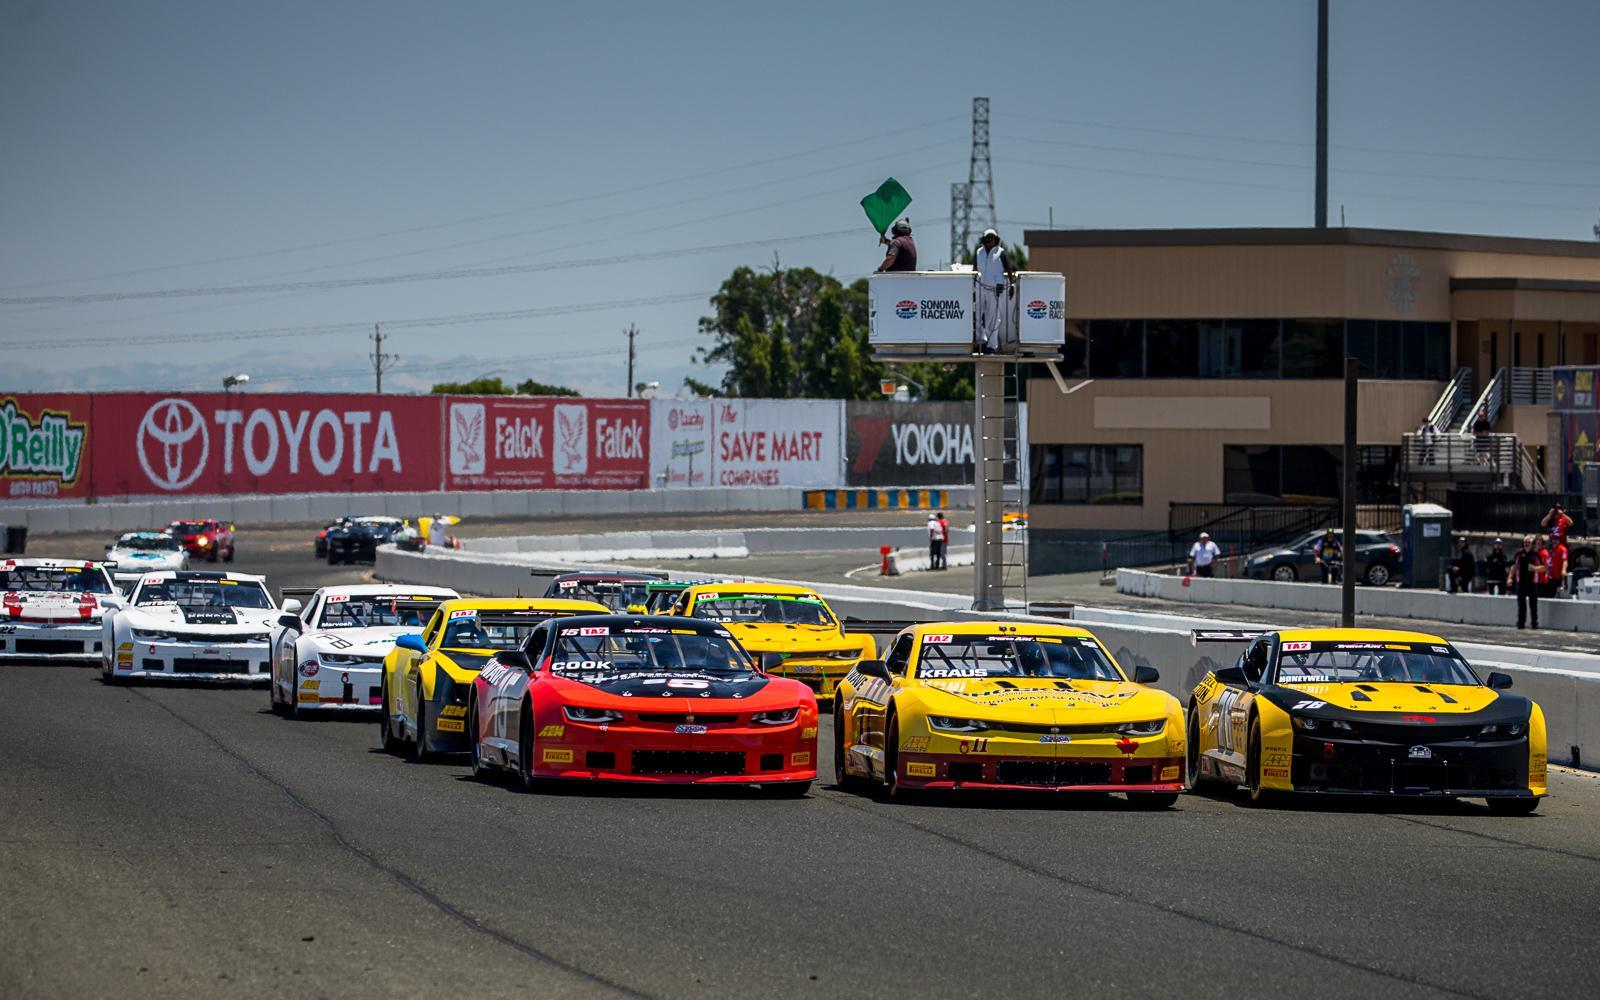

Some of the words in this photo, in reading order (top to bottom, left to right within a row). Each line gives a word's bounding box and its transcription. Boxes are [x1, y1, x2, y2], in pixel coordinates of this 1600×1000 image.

[920, 300, 960, 310] SONOMA
[920, 310, 964, 320] RACEWAY
[720, 404, 737, 425] The
[215, 409, 401, 476] TOYOTA
[495, 417, 544, 459] Falck
[595, 418, 643, 459] Falck
[720, 432, 766, 462] SAVE
[771, 432, 823, 462] MART
[720, 470, 779, 487] COMPANIES
[454, 610, 474, 618] TA2
[561, 628, 579, 636] 15
[552, 661, 611, 671] COOK
[920, 669, 988, 678] KRAUS
[1279, 675, 1329, 683] HONEYWELL
[971, 738, 988, 753] 11
[1264, 768, 1288, 778] PIRELLI
